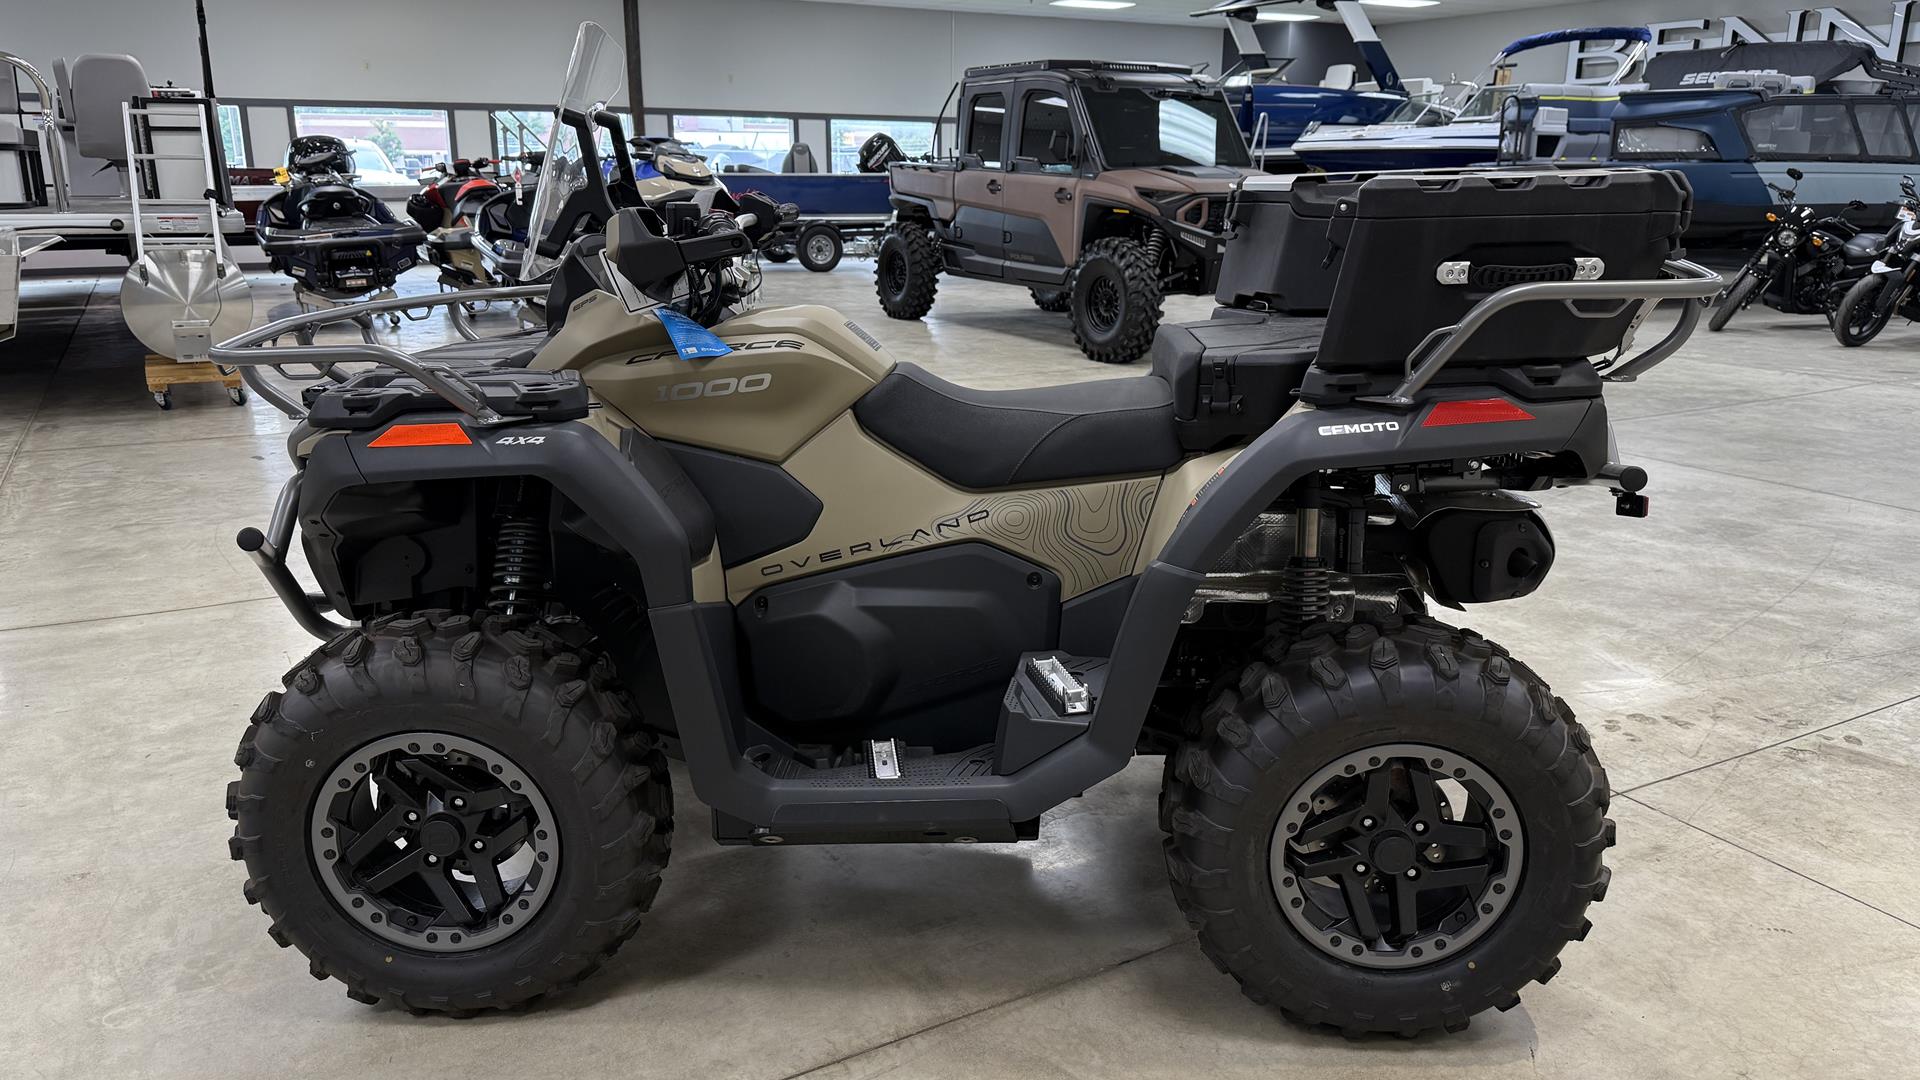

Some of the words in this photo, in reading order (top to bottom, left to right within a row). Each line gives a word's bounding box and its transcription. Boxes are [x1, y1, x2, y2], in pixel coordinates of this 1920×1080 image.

[625, 339, 805, 365] CFRCE
[656, 373, 772, 402] 1000
[761, 509, 990, 577] OVERLAND
